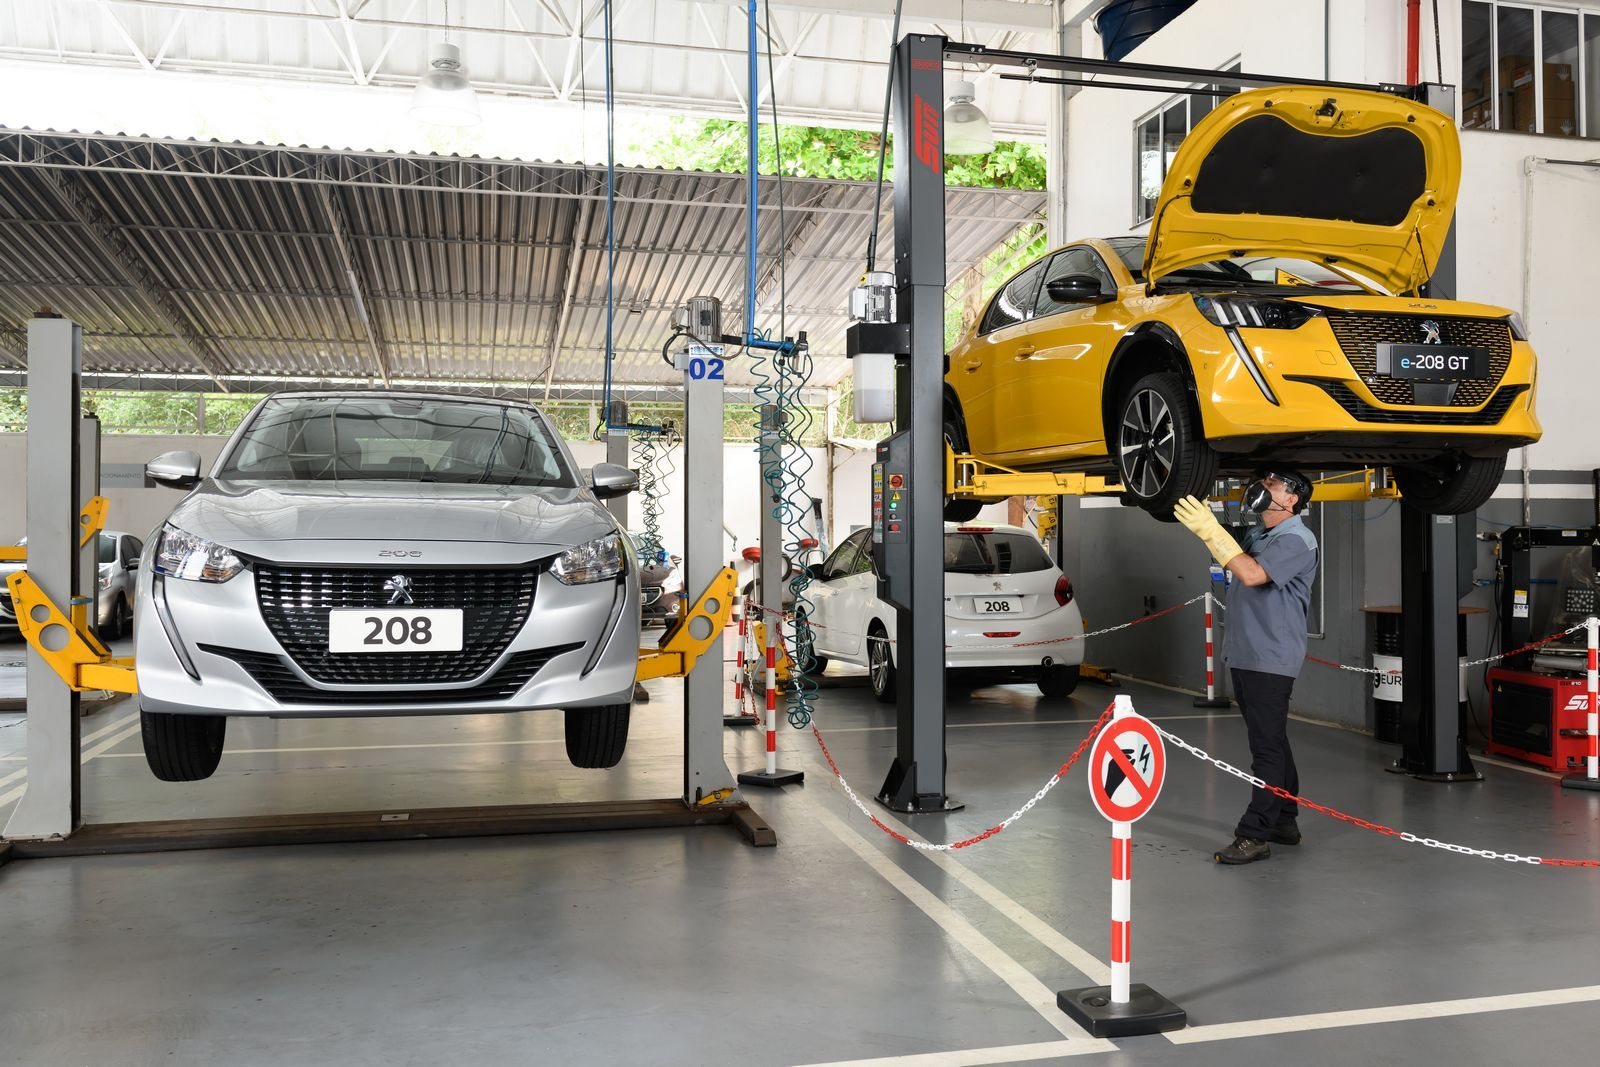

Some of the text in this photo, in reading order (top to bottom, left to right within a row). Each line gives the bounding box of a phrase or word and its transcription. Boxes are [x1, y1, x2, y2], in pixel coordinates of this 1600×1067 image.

[689, 358, 724, 380] 02
[1400, 354, 1469, 370] e-208 GT
[378, 550, 423, 558] 208
[984, 601, 1010, 612] 208
[363, 616, 432, 645] 208
[1381, 674, 1402, 686] EUR
